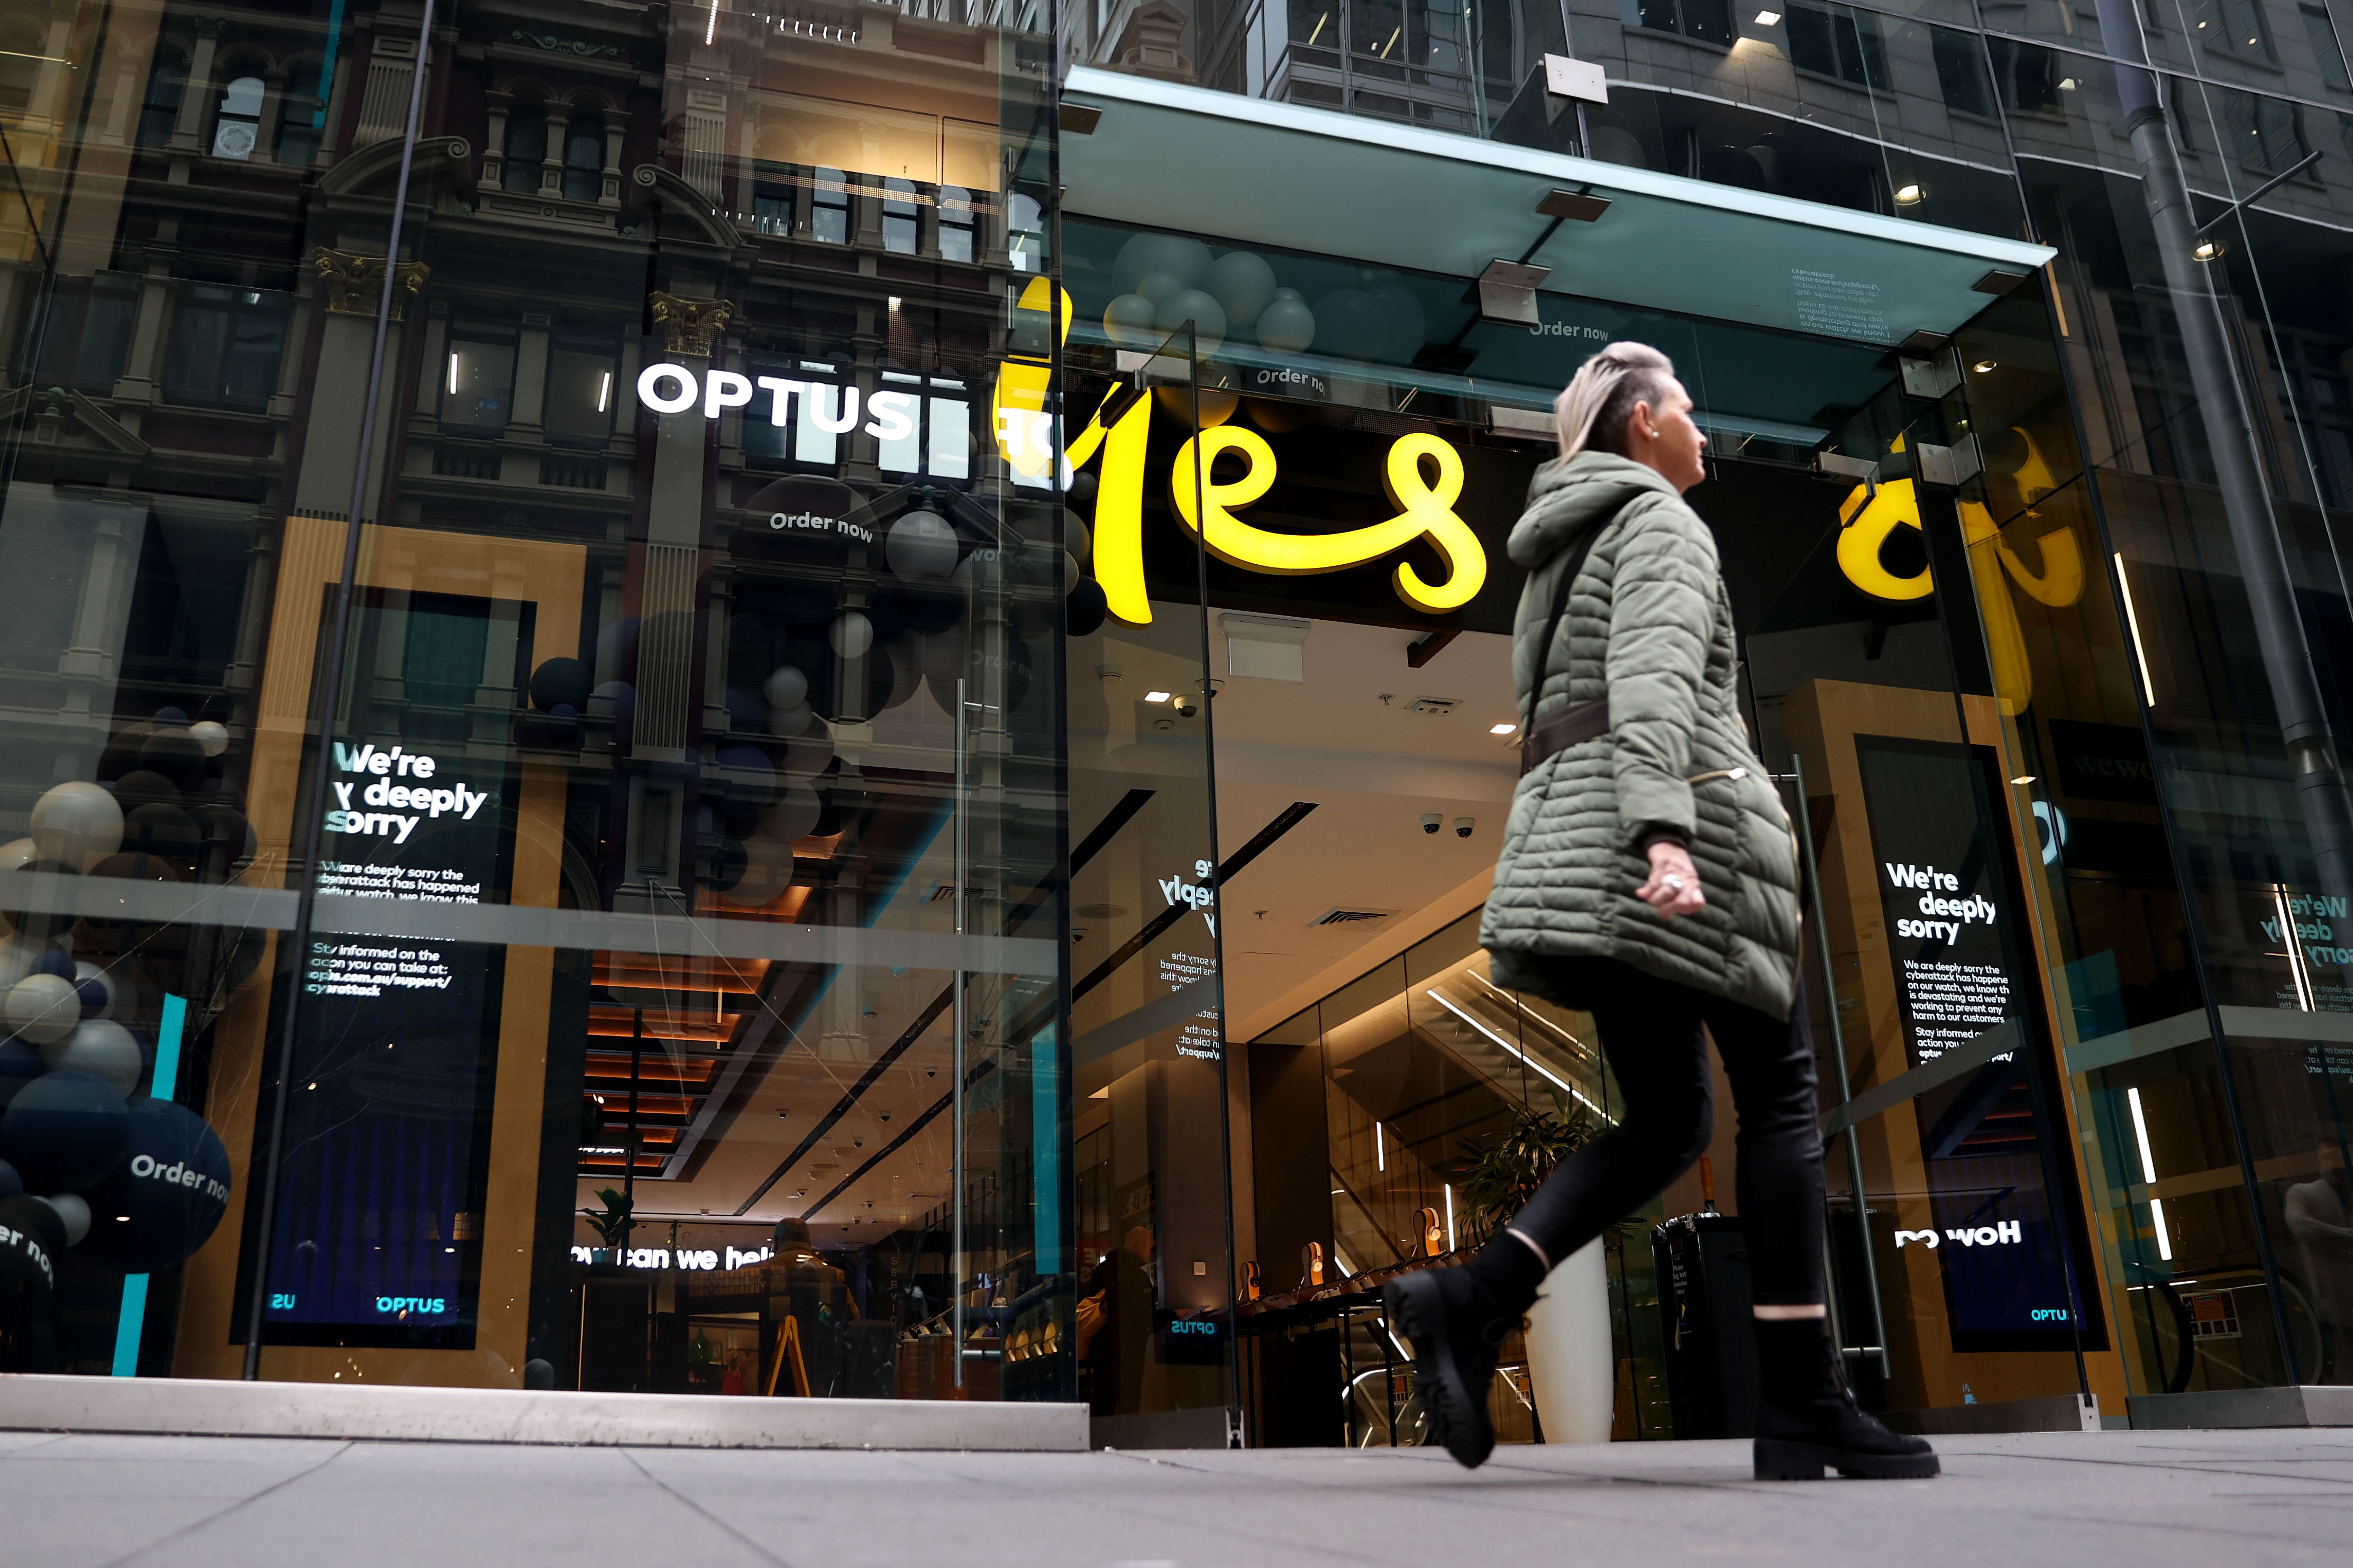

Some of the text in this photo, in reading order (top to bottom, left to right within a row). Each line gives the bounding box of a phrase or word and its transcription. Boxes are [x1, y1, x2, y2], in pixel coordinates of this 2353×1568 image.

[1529, 321, 1609, 342] Order now
[1257, 368, 1325, 397] Order no
[637, 363, 914, 441] OPTUS
[770, 511, 873, 544] Order now
[364, 777, 488, 820] deeply
[364, 863, 406, 878] deeply
[407, 869, 441, 881] sorry
[442, 869, 464, 881] the
[1886, 863, 1959, 892] We're
[392, 877, 416, 890] has
[417, 879, 480, 894] happened
[1919, 891, 1995, 924] deeply
[1897, 919, 1959, 946] sorry
[339, 945, 398, 959] informed
[398, 951, 416, 960] on
[418, 949, 440, 961] the
[346, 960, 371, 971] you
[372, 962, 396, 972] can
[398, 961, 427, 973] take
[429, 965, 449, 975] at:
[1903, 959, 1919, 969] We
[1935, 961, 1962, 974] deeply
[1963, 966, 1984, 975] sorry
[1984, 965, 2000, 974] the
[1906, 970, 2009, 985] cyberattack has happene
[1909, 991, 2007, 1004] is devastating and we're
[1934, 983, 1962, 993] watch,
[1976, 984, 1998, 994] know
[1999, 985, 2010, 995] th
[1911, 1001, 2003, 1015] working to prevent any
[1912, 1010, 1936, 1020] harm
[1936, 1012, 1946, 1021] to
[1916, 1027, 1935, 1038] Stay
[1936, 1028, 1974, 1039] informed
[1917, 1039, 1944, 1048] action
[131, 1154, 206, 1189] Order
[677, 1249, 718, 1270] we
[890, 1256, 898, 1324] SERVIC
[376, 1297, 445, 1313] OPTUS
[2031, 1309, 2077, 1322] OPTU
